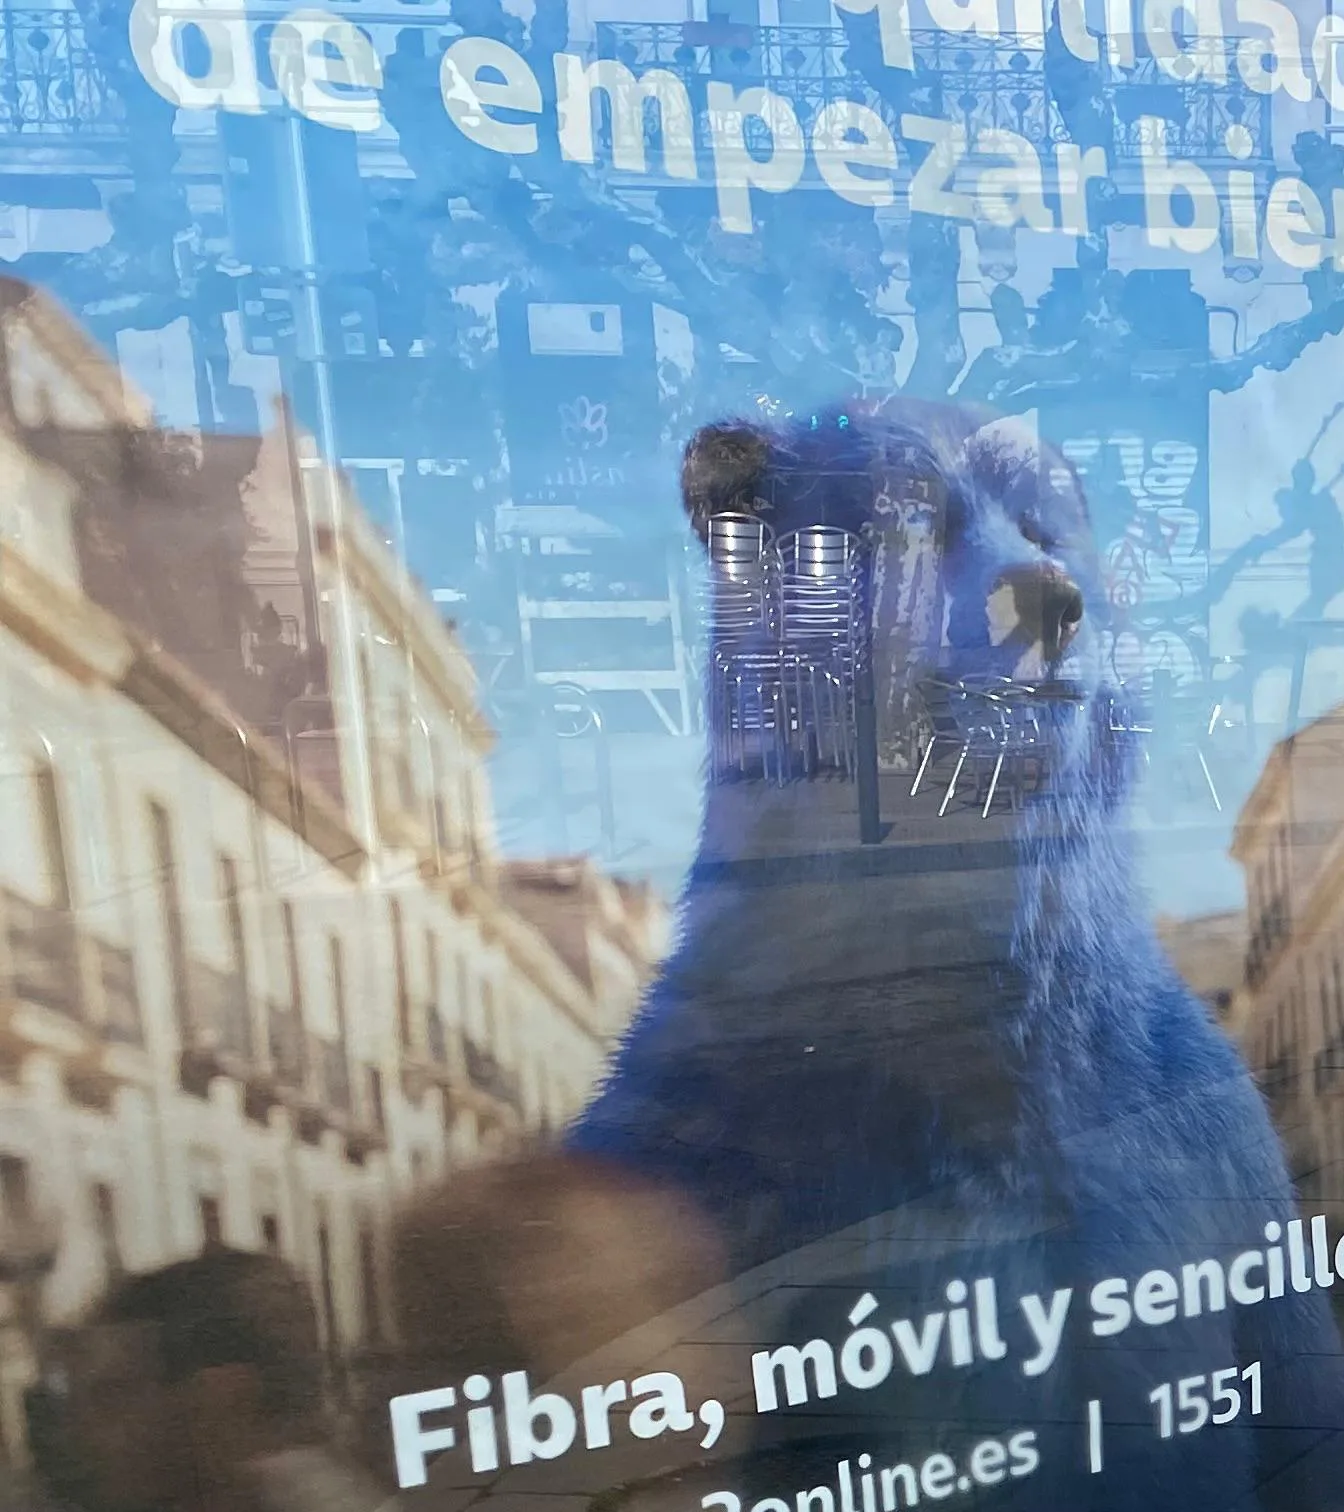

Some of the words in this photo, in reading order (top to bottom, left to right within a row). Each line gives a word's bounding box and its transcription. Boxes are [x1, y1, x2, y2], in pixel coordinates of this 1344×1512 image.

[439, 36, 1108, 236] empezar
[389, 1371, 728, 1488] Fibra,
[752, 1281, 1007, 1413] móvil
[1020, 1283, 1071, 1376] y
[1148, 1360, 1263, 1439] 1551
